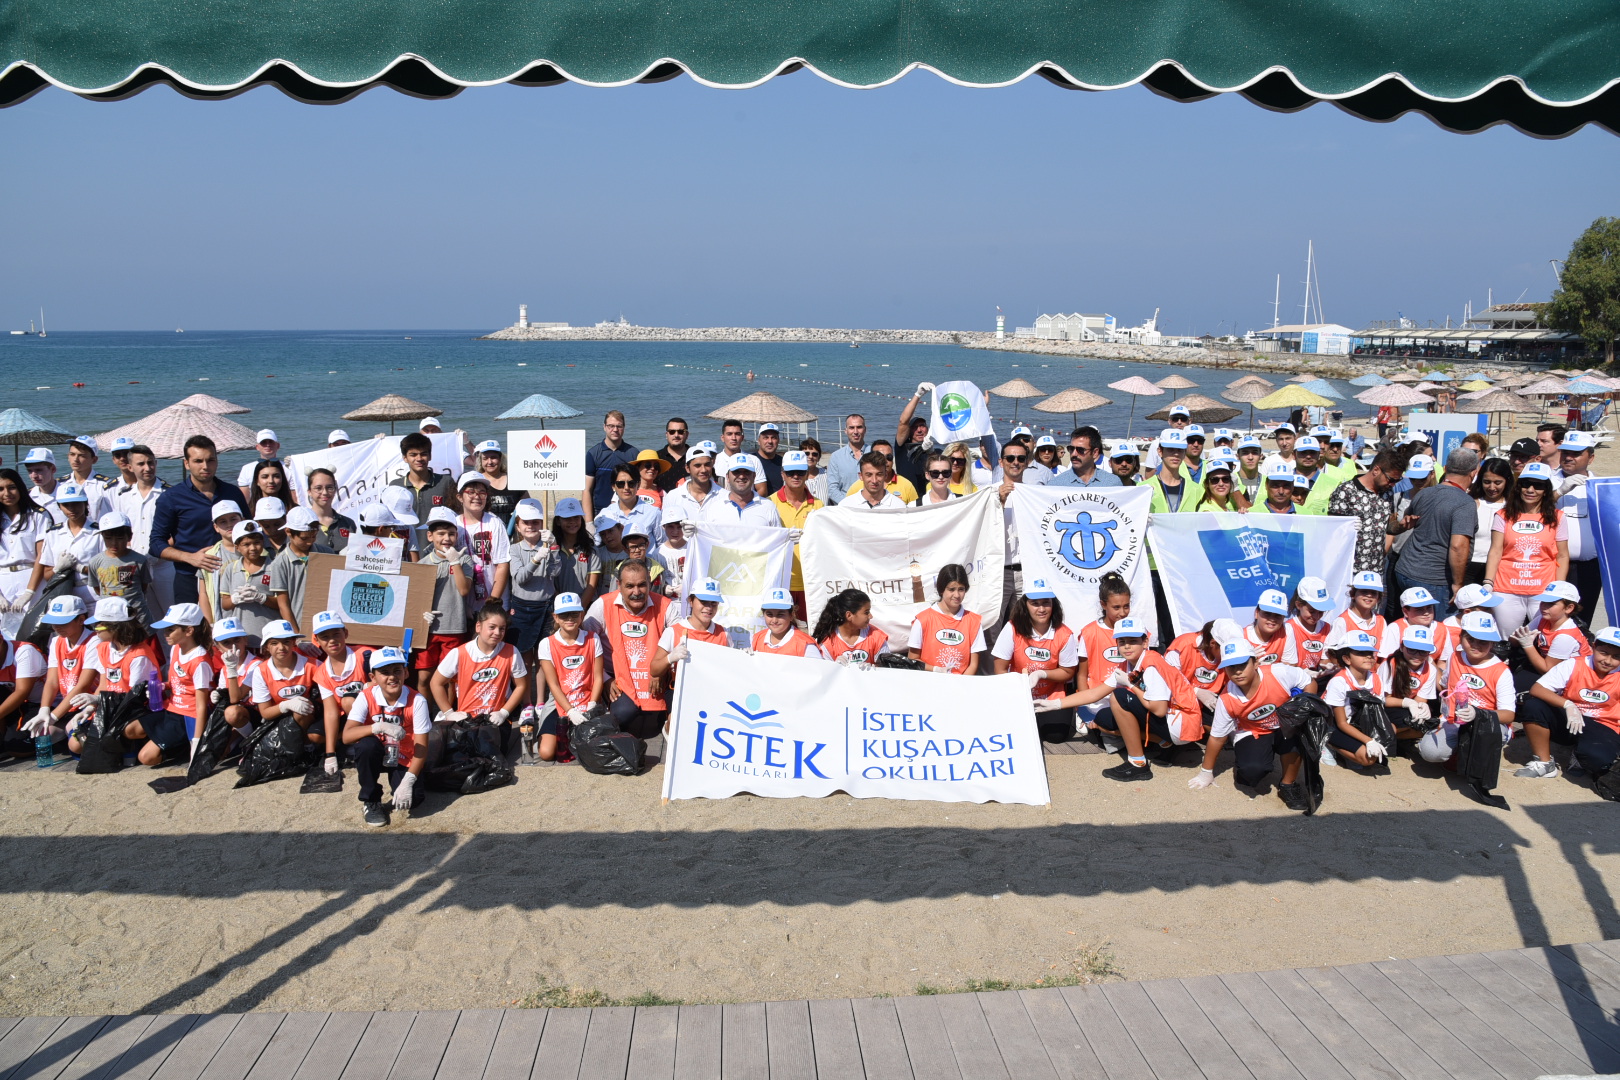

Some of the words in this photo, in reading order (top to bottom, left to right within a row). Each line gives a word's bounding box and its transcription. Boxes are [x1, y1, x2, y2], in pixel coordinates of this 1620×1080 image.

[523, 460, 569, 470] Bahçeşehir
[533, 471, 558, 482] Koleji
[1041, 503, 1061, 531] DENİZ
[1060, 493, 1108, 507] TİCARET
[1107, 501, 1133, 526] ODASI
[355, 555, 393, 565] Bahçeşehir
[1043, 540, 1085, 583] CHAMBER
[1116, 536, 1137, 574] HIPPING
[363, 563, 384, 573] Koleji
[1227, 564, 1264, 580] EGE
[1519, 569, 1533, 578] ÇÖL
[1510, 578, 1542, 586] OLMASIN
[353, 593, 384, 602] GELECEK
[351, 606, 382, 615] GELECEK
[942, 631, 957, 639] TEMA
[1030, 649, 1045, 657] TEMA
[1254, 708, 1269, 717] TEMA
[862, 707, 936, 732] İSTEK
[692, 710, 834, 779] İSTEK
[862, 733, 1014, 762] KUŞADASI
[709, 760, 787, 779] OKULLARI
[862, 757, 1015, 781] OKULLARI
